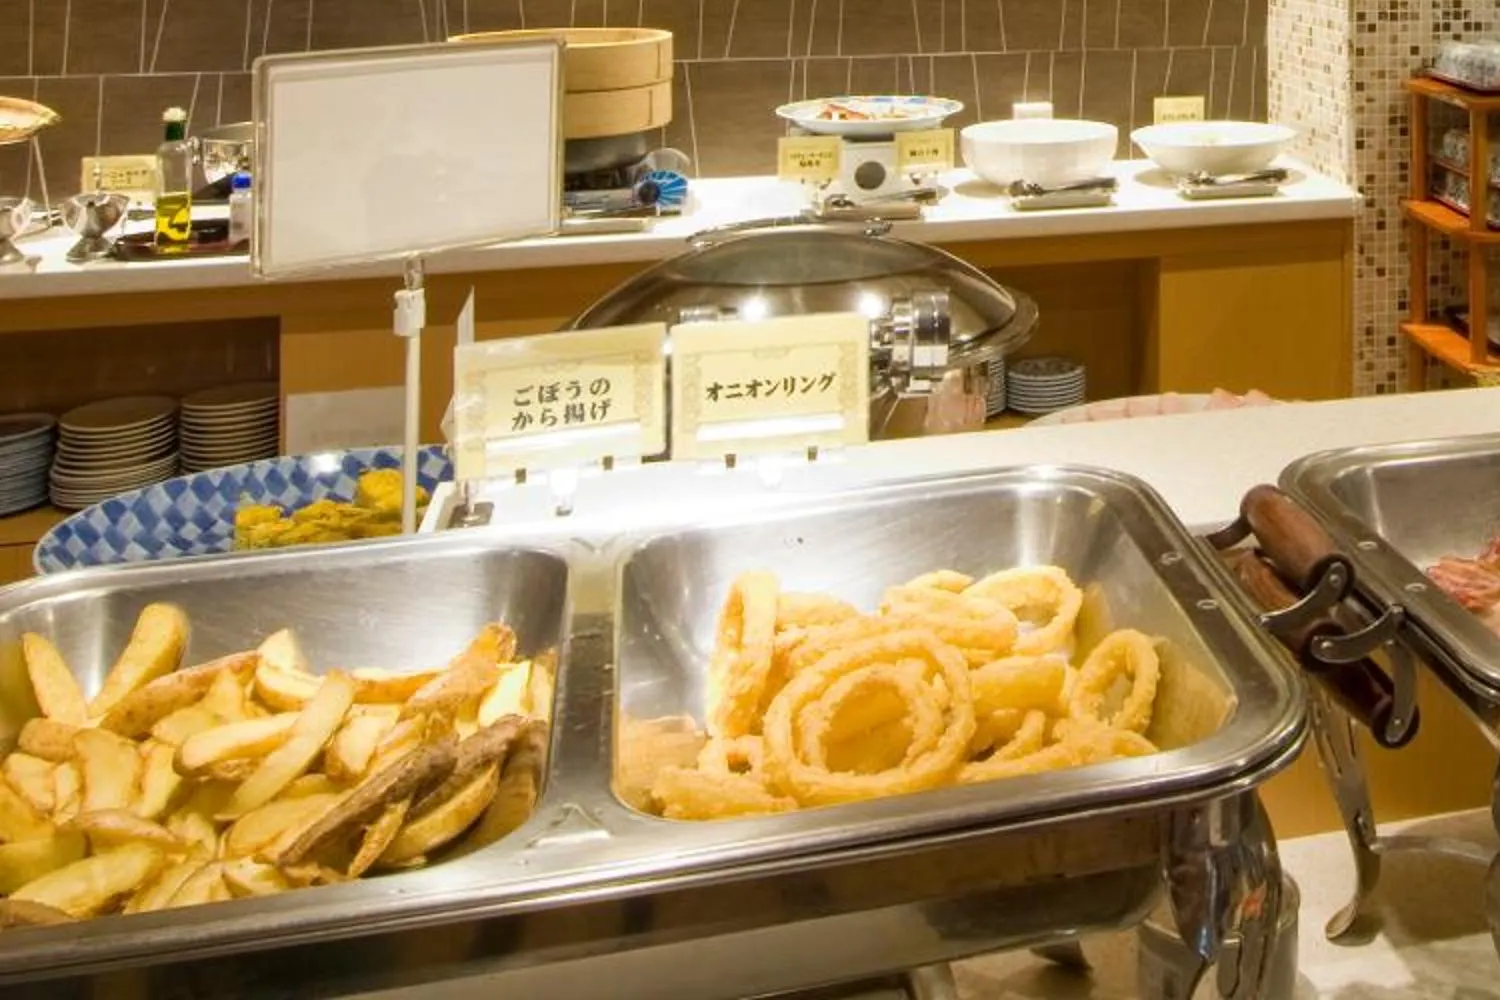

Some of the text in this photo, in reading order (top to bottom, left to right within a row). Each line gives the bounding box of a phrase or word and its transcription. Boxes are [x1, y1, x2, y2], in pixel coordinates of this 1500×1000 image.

[513, 376, 612, 408] ごぼうの
[705, 371, 837, 402] オニオンリング
[511, 398, 612, 432] から揚げ
